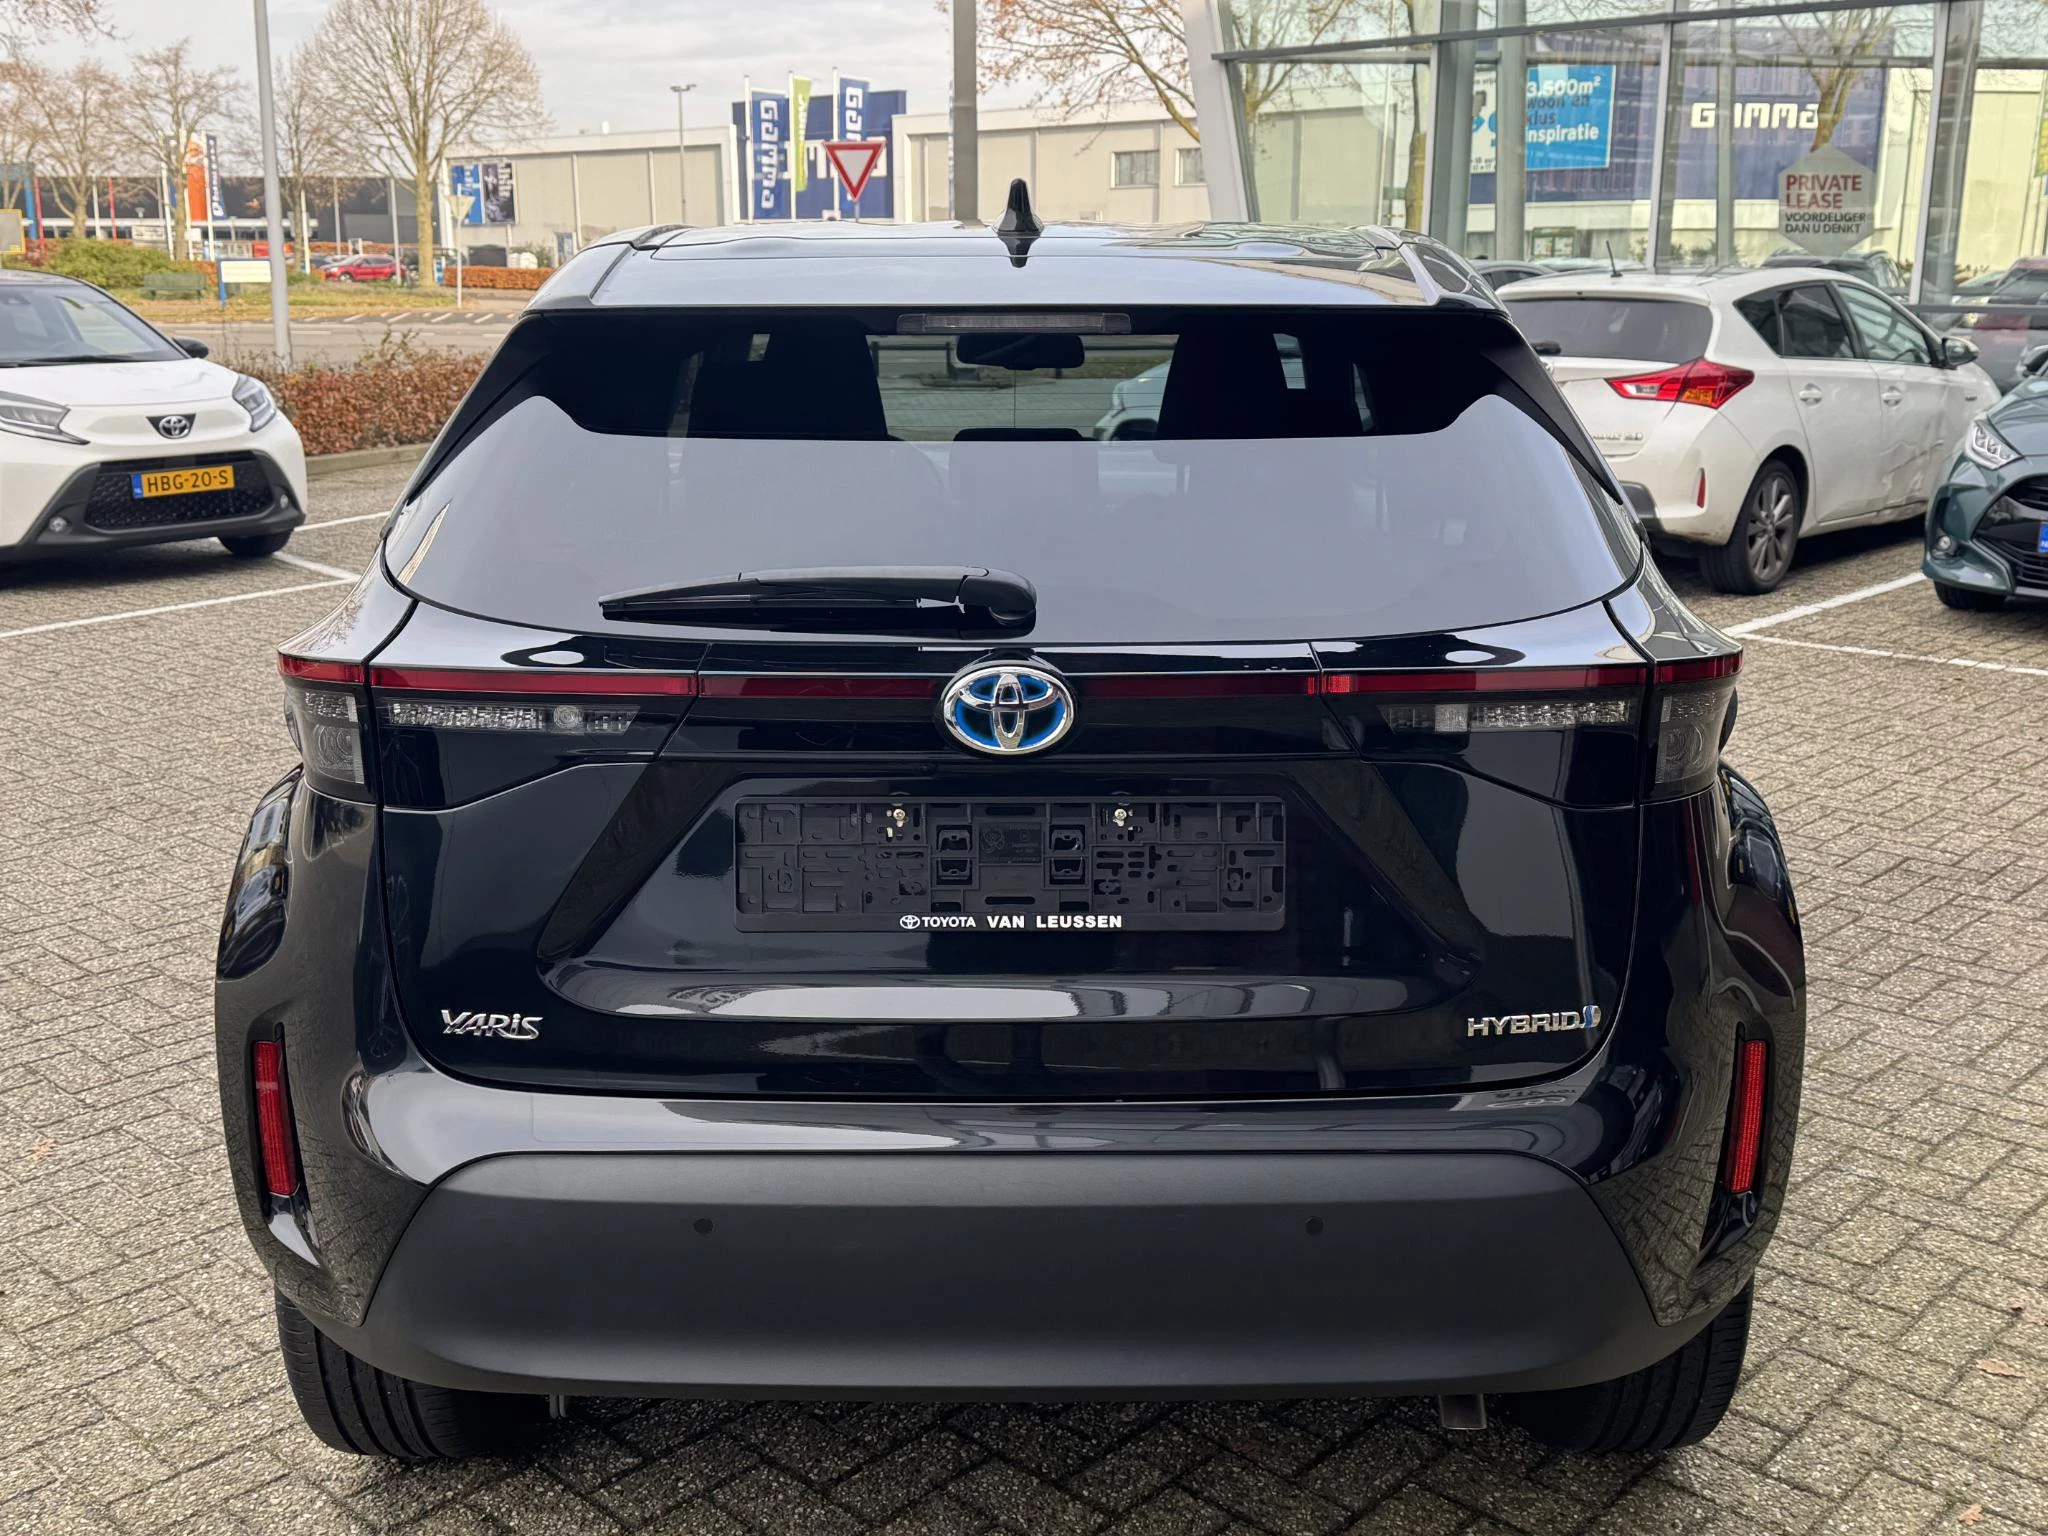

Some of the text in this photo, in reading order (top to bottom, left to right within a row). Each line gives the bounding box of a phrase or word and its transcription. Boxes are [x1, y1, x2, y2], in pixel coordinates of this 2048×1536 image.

[1786, 174, 1862, 191] PRIVATE
[1786, 193, 1843, 209] LEASE
[1785, 212, 1866, 223] VOORDELIGER
[1785, 223, 1861, 234] DAN U DENKT
[147, 470, 228, 493] HBG-20-S
[922, 915, 1122, 929] TOYOTA VAN LEUSSEN
[1467, 1011, 1582, 1037] HYBRID
